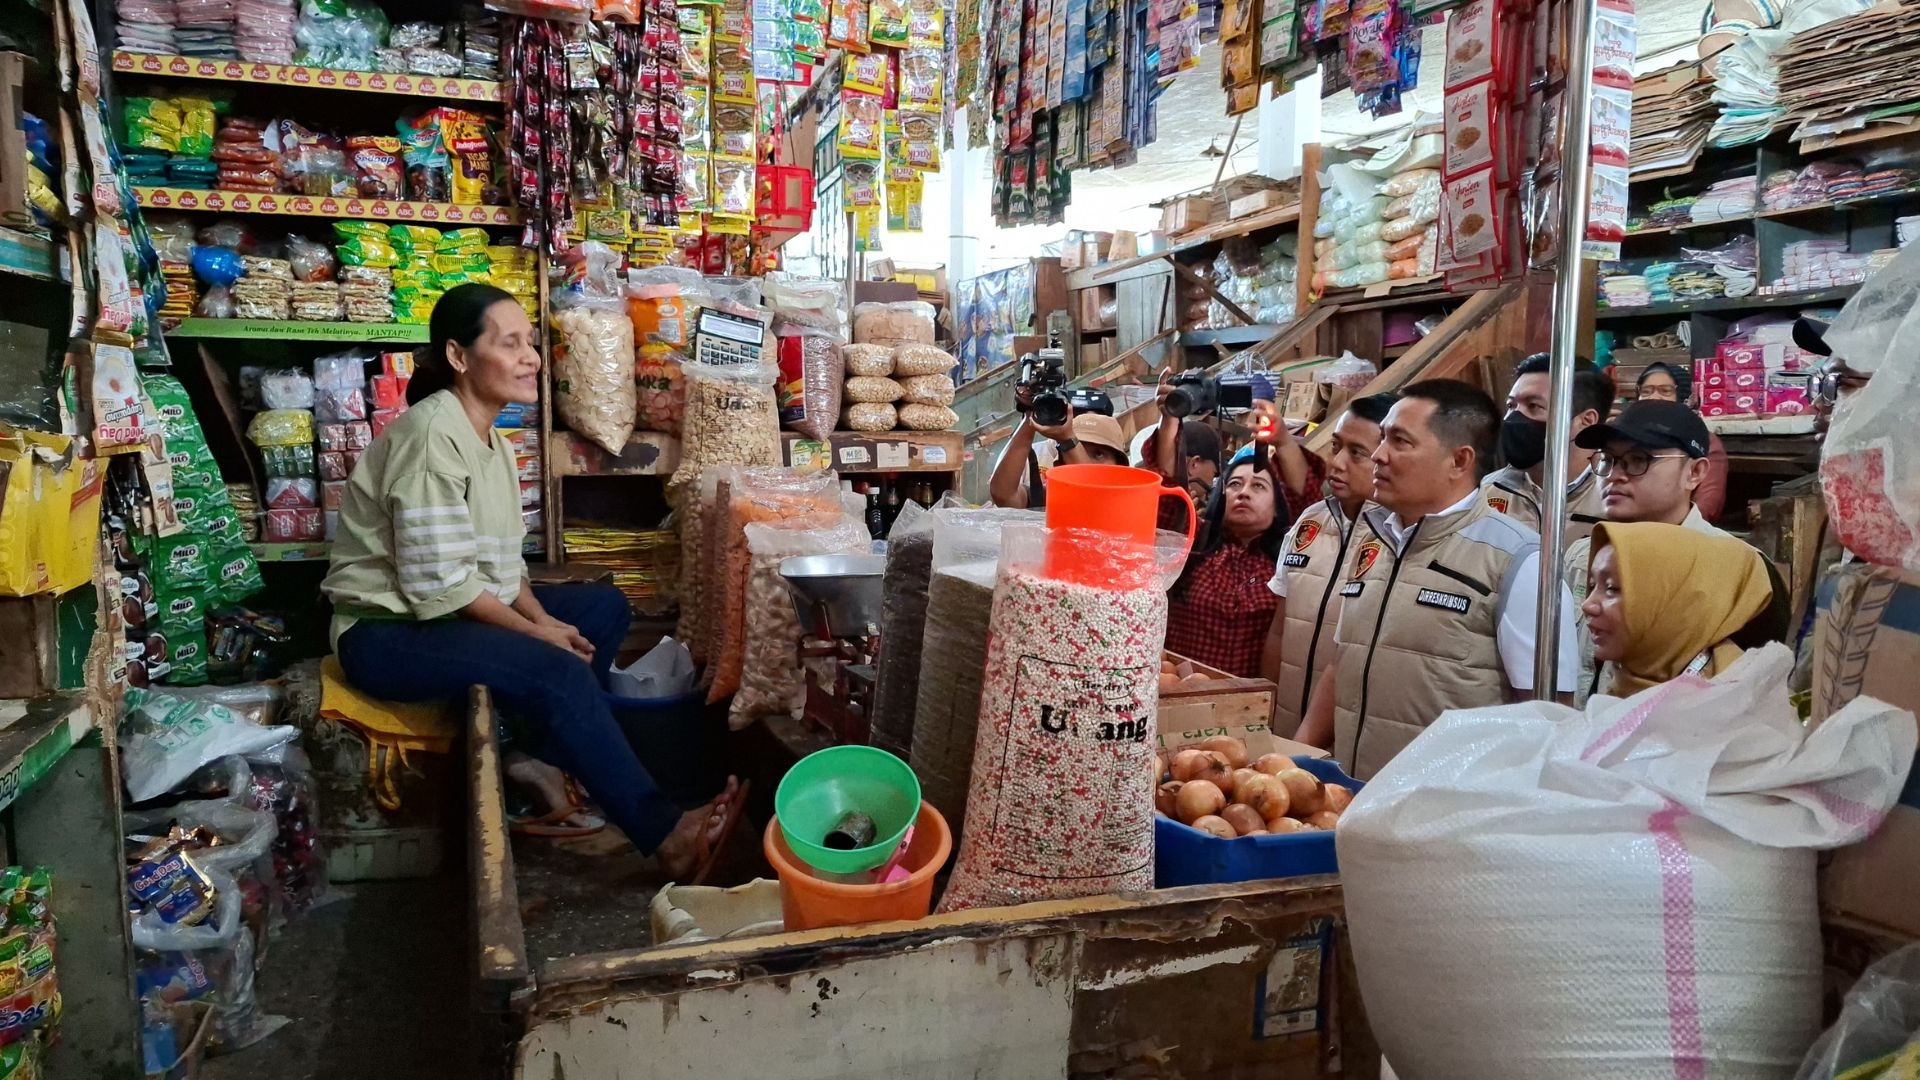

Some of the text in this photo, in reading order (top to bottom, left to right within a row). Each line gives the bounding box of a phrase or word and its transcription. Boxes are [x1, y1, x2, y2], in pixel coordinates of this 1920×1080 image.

[115, 58, 135, 68] ABC
[143, 60, 161, 70] ABC
[170, 63, 189, 73] ABC
[198, 65, 216, 75] ABC
[225, 67, 244, 77] ABC
[252, 69, 271, 79] ABC
[856, 67, 880, 78] Racik
[292, 72, 311, 82] ABC
[318, 74, 336, 84] ABC
[343, 76, 362, 86] ABC
[368, 78, 387, 88] ABC
[394, 80, 412, 91] ABC
[419, 82, 438, 92] ABC
[723, 79, 747, 90] Racik
[443, 85, 462, 95] ABC
[468, 87, 485, 98] ABC
[456, 141, 488, 150] Indofood
[354, 152, 396, 165] Sedaap
[908, 149, 932, 160] Racik
[151, 194, 171, 204] ABC
[179, 196, 198, 206] ABC
[206, 198, 225, 208] ABC
[233, 200, 252, 210] ABC
[259, 202, 278, 211] ABC
[295, 203, 313, 213] ABC
[320, 203, 339, 213] ABC
[346, 204, 364, 214] ABC
[371, 206, 390, 216] ABC
[396, 208, 415, 217] ABC
[421, 208, 439, 218] ABC
[445, 210, 463, 219] ABC
[470, 211, 488, 221] ABC
[494, 213, 510, 222] ABC
[162, 408, 182, 416] MILO
[99, 423, 124, 443] Day
[172, 547, 196, 558] MILO
[223, 561, 245, 577] MILO
[171, 599, 193, 611] MILO
[176, 646, 196, 660] MILO
[134, 872, 161, 892] Good
[159, 860, 181, 877] Day
